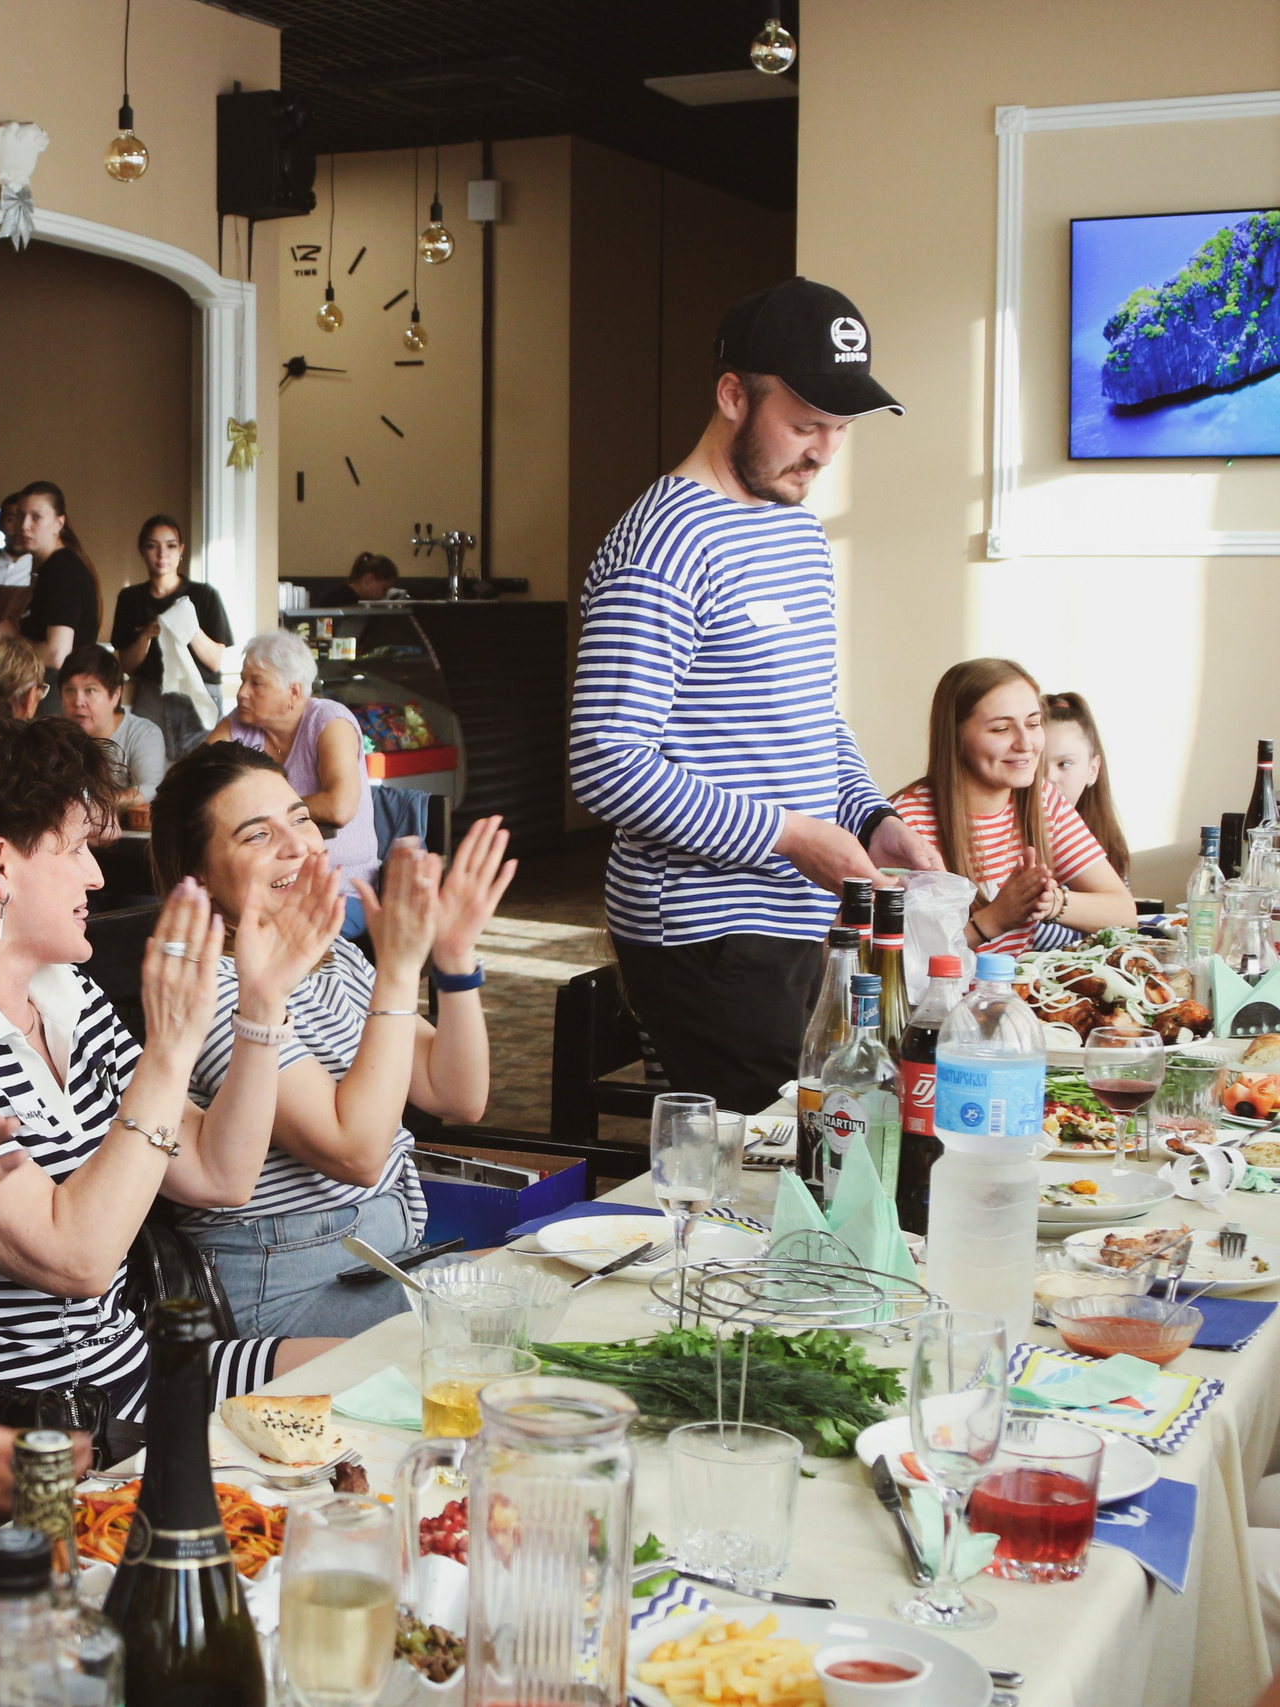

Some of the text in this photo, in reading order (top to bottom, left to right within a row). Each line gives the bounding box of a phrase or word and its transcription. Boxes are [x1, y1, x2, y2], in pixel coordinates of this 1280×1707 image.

[290, 245, 322, 262] 12
[294, 268, 317, 277] TIME
[834, 351, 868, 363] HINO
[824, 1113, 865, 1133] MARTINI
